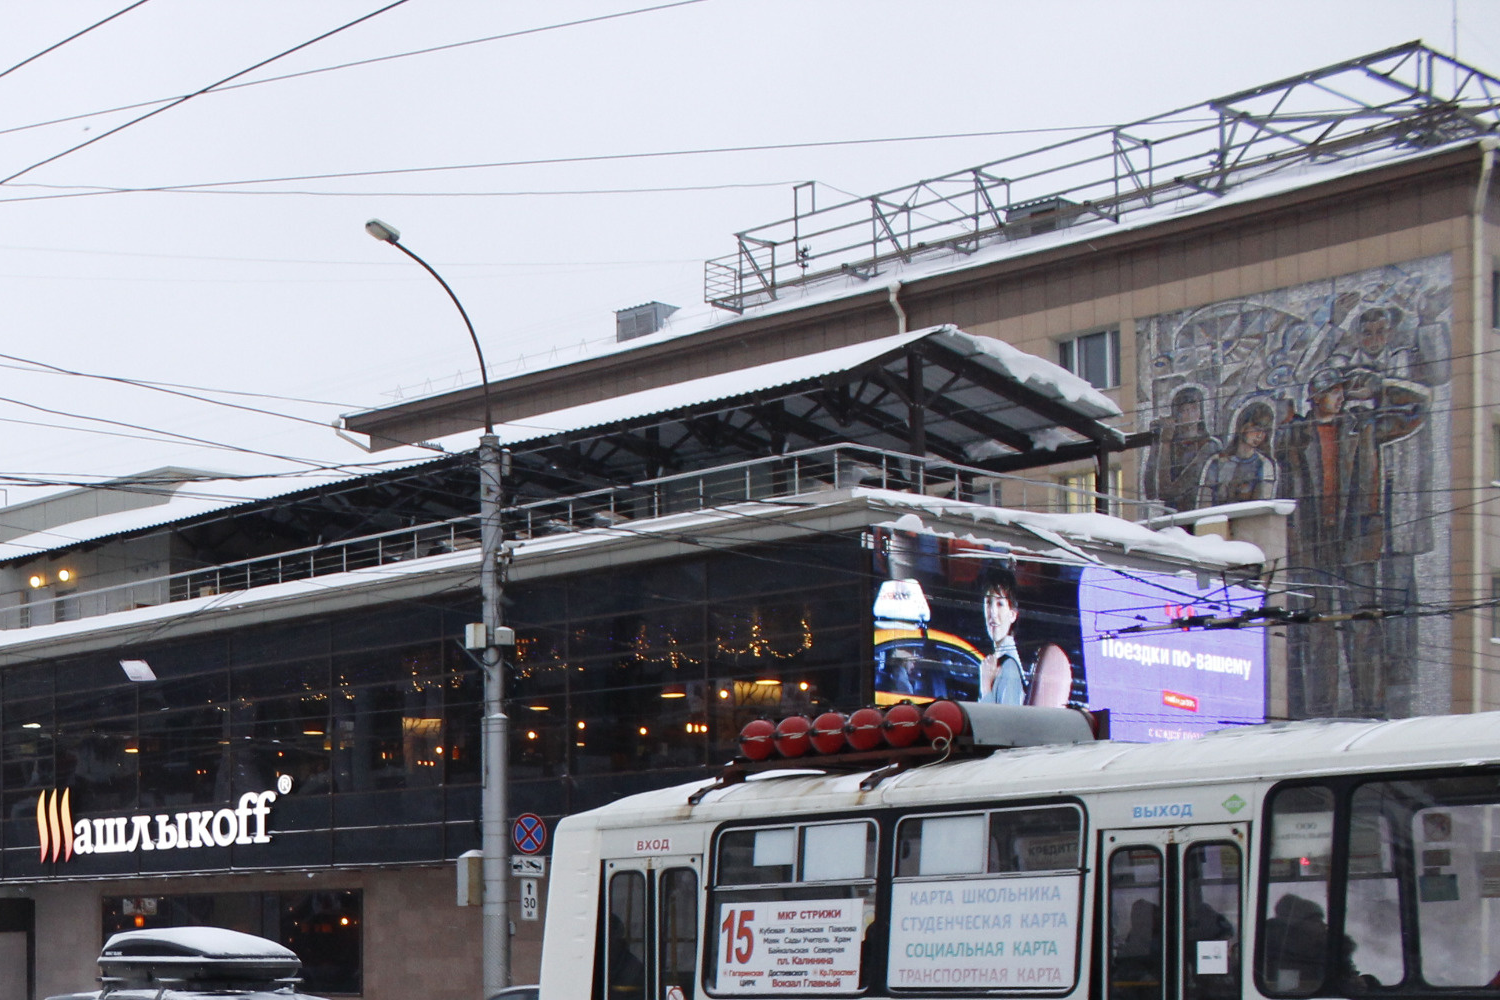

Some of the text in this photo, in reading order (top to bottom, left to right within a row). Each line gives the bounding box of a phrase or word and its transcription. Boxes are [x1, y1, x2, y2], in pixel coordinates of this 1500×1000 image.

[1101, 638, 1252, 681] Поездки по-вашему
[1133, 804, 1193, 818] ВЫХОД
[636, 839, 669, 851] ВХОД
[910, 886, 1061, 905] КАРТА ШКОЛЬНИКА
[523, 897, 536, 908] 30
[777, 909, 841, 920] МКР СТРИЖИ
[901, 912, 1068, 934] СТУДЕНЧЕСКАЯ КАРТА
[722, 909, 755, 964] 15
[759, 927, 786, 935] Кубовая
[905, 941, 1058, 960] СОЦИАЛЬНАЯ КАРТА
[792, 956, 834, 965] Калинина
[767, 969, 809, 978] Достоевского
[898, 967, 1062, 983] ТРАНСПОРТНАЯ КАРТА
[772, 979, 801, 987] Вокзал
[803, 978, 841, 987] Главный
